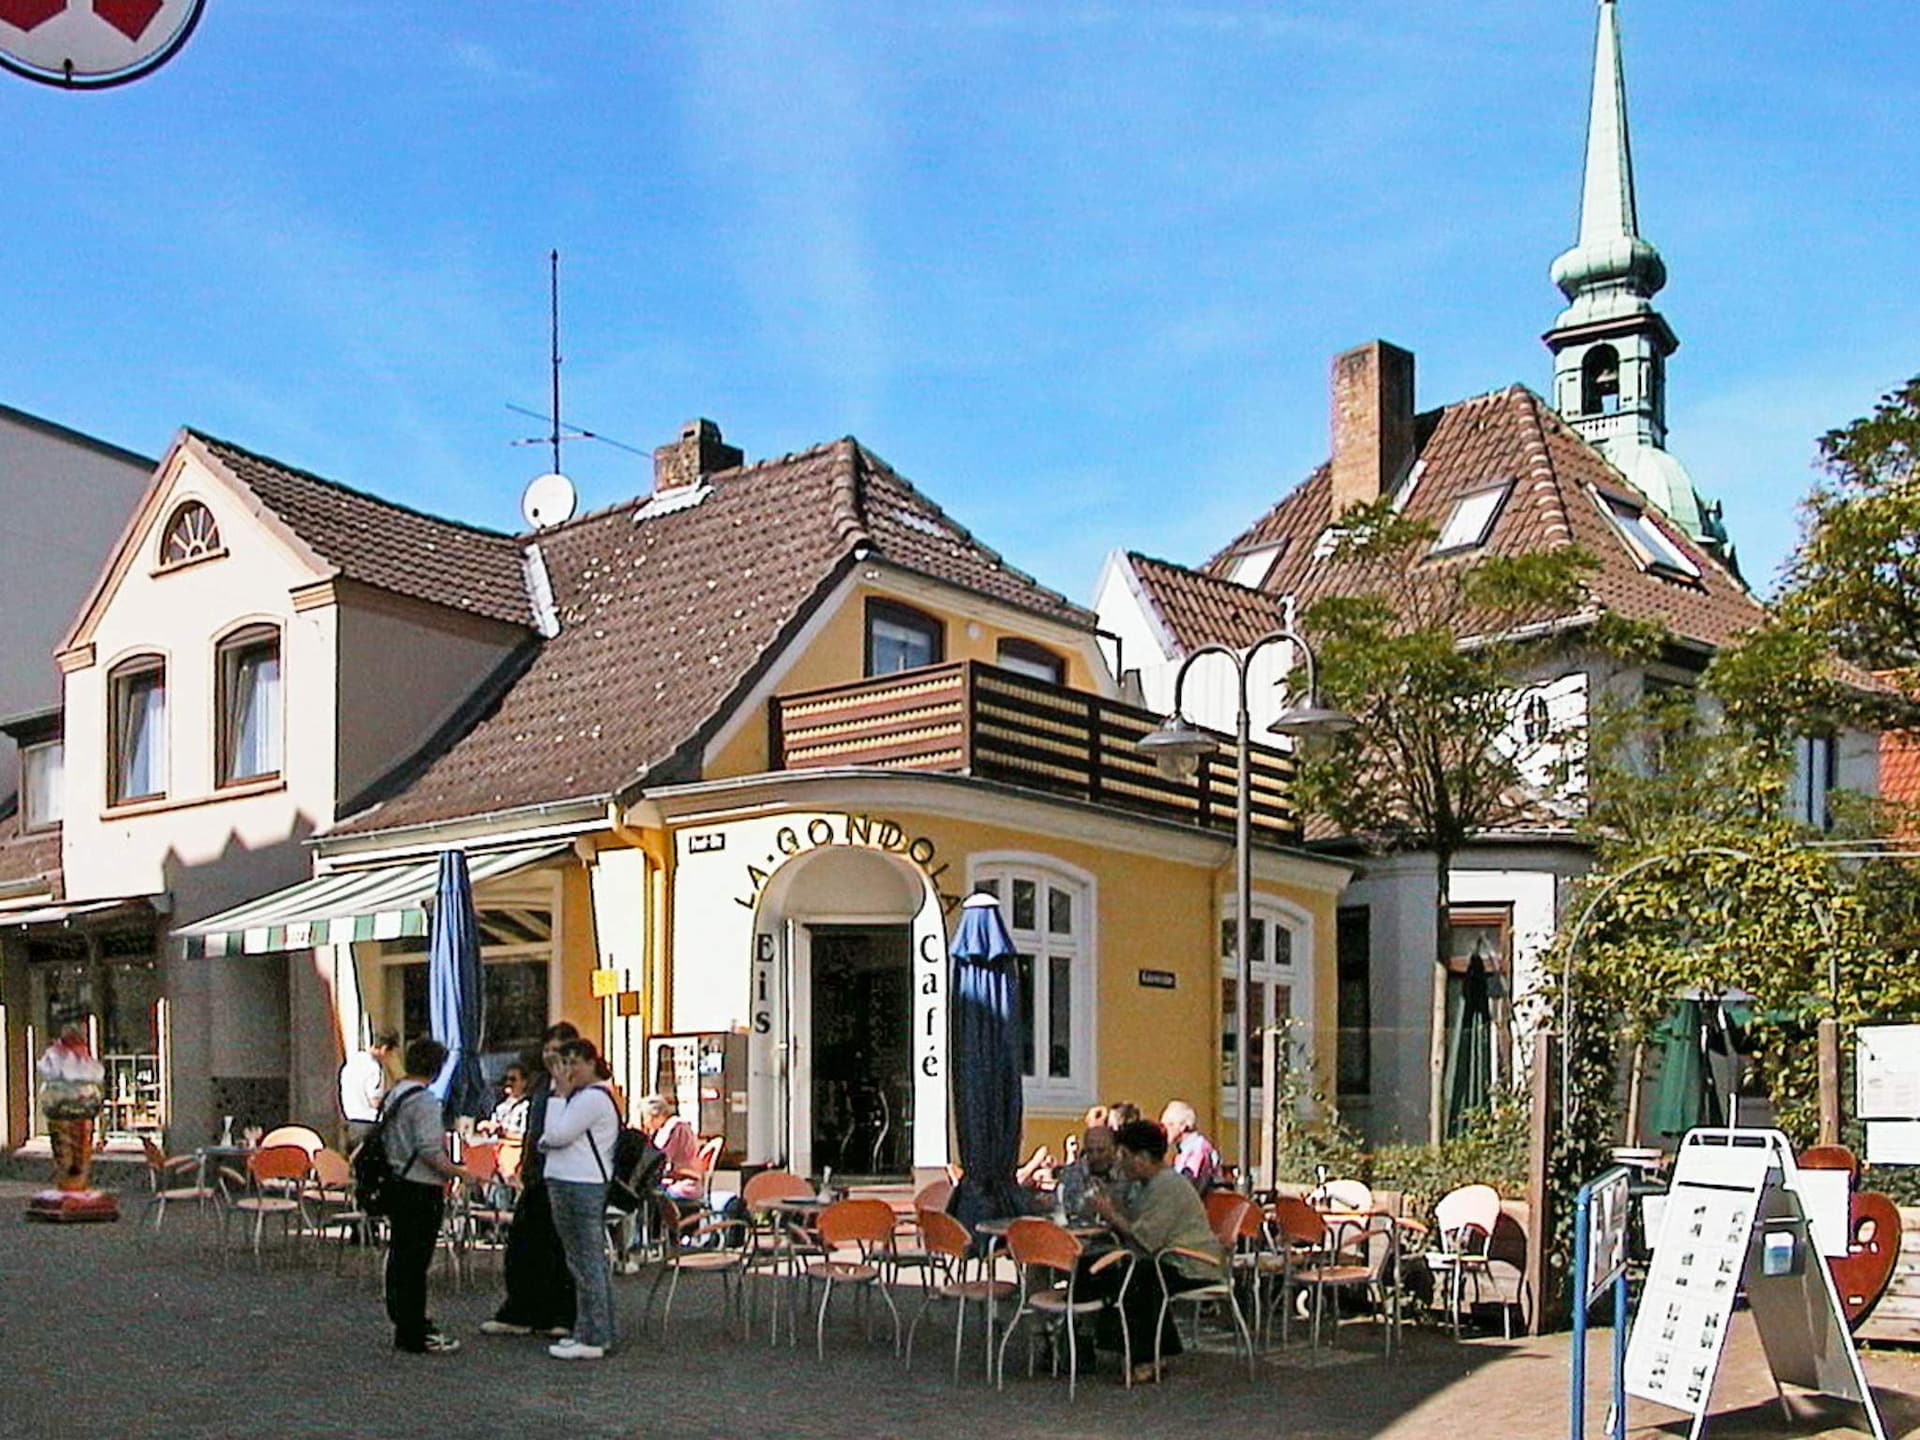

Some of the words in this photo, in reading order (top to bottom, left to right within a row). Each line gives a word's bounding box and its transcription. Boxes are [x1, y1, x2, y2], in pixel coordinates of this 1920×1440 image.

[776, 814, 961, 915] GONDOLA
[755, 934, 775, 1034] Eis
[920, 934, 938, 1077] Café
